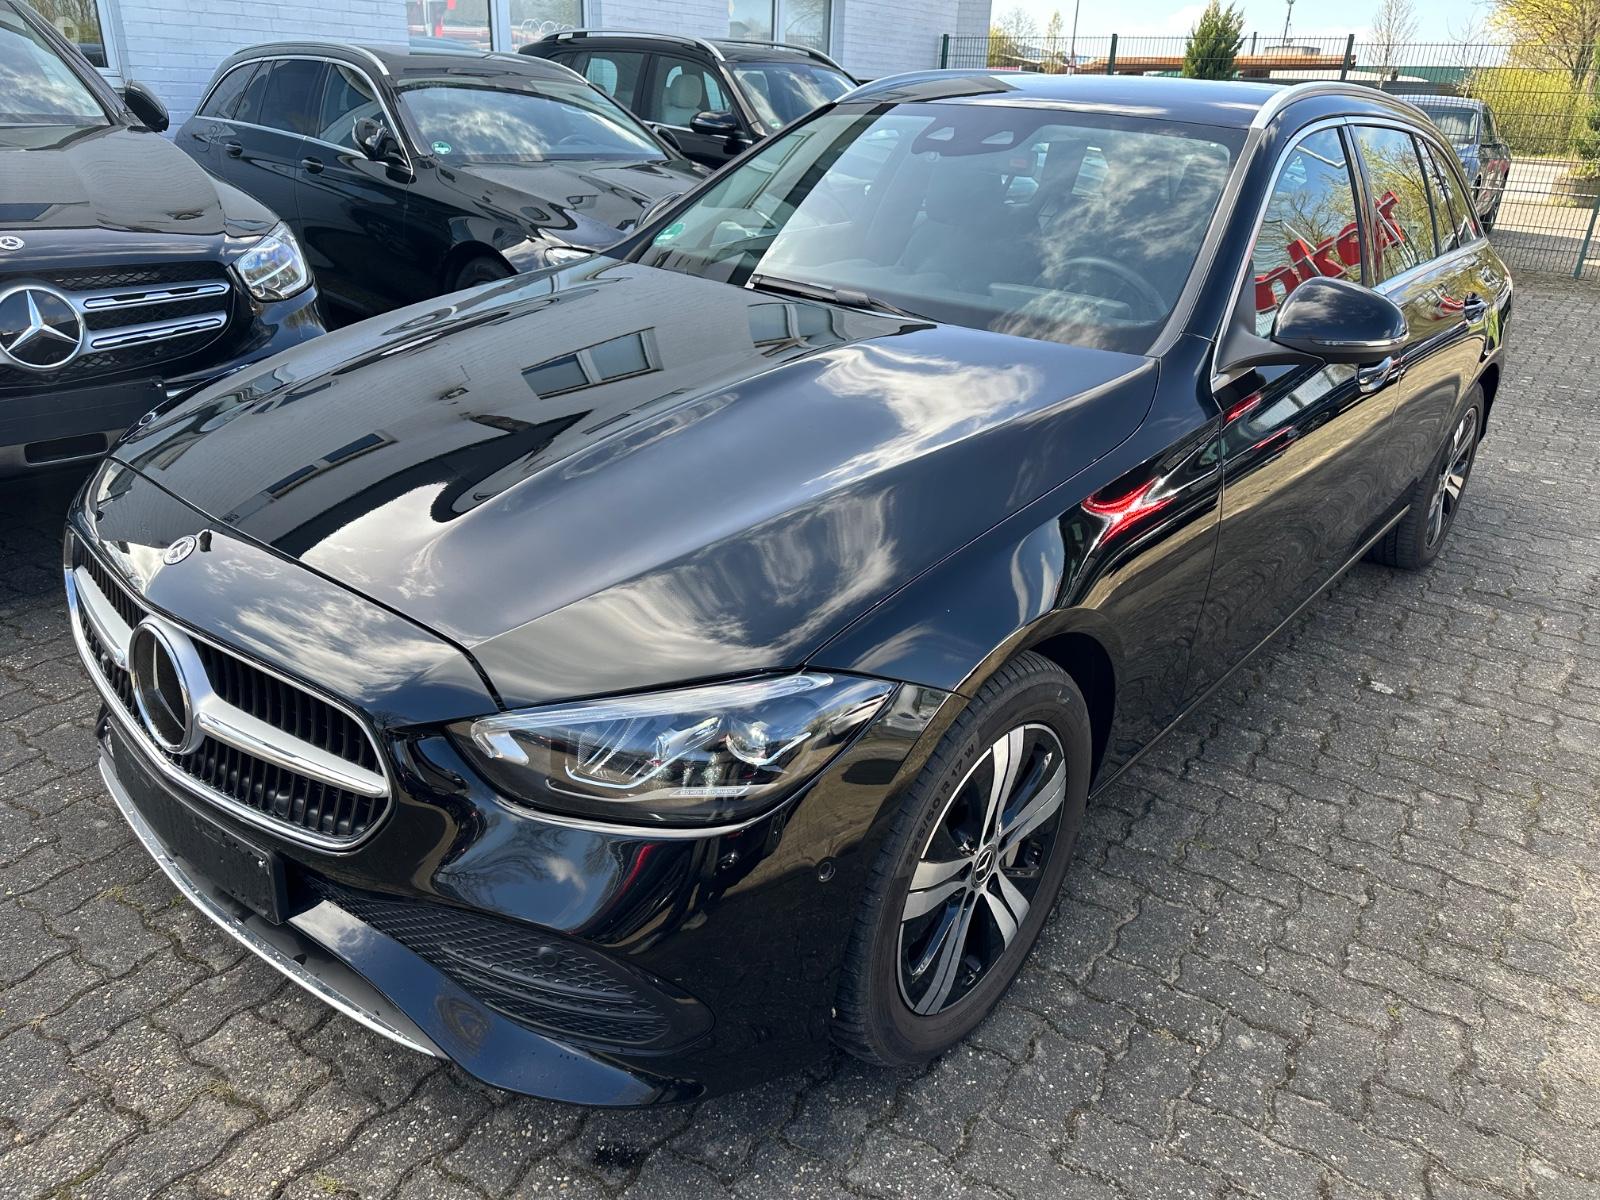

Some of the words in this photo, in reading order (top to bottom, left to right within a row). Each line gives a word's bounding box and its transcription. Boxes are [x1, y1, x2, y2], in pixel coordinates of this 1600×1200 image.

[941, 781, 950, 794] R
[951, 760, 962, 777] 17
[964, 743, 975, 759] W
